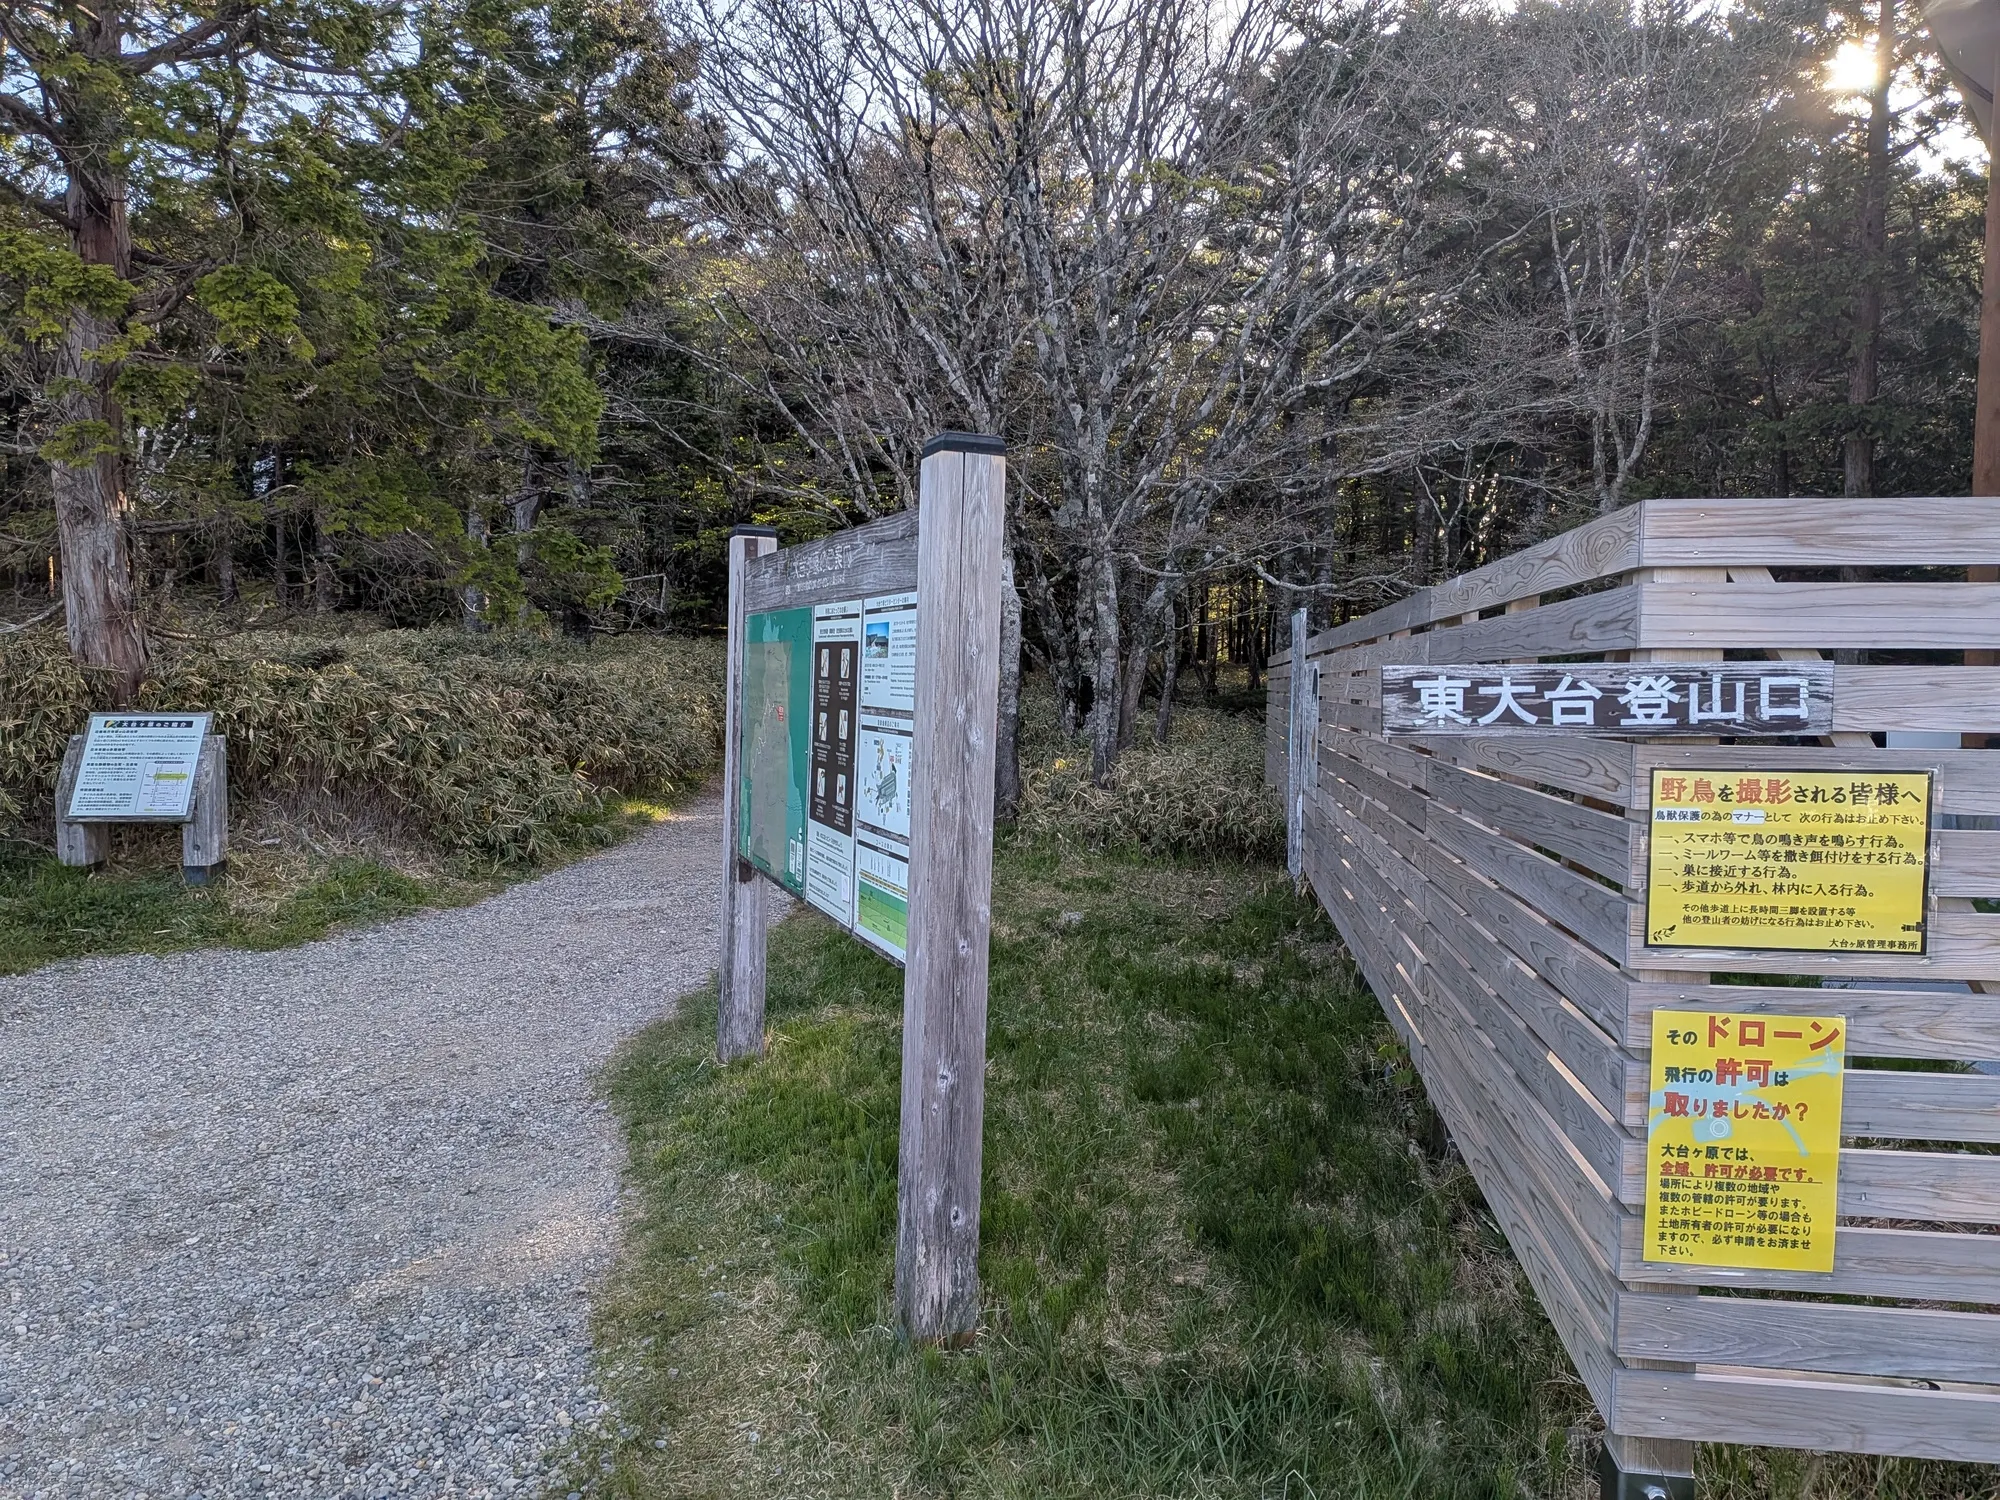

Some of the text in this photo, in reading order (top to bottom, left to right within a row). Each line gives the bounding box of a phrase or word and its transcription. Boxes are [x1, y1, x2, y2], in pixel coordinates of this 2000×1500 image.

[1413, 673, 1809, 726] 東大台 登山口
[1661, 777, 1921, 806] 野鳥を撮影される皆様へ
[1655, 810, 1924, 826] 鳥獣保護の為のマナーとして 次の行為はお止め下さい。
[1659, 831, 1905, 849] 一、スマホ等で鳥の鳴き声を鳴らす行為。
[1658, 848, 1925, 866] 一、ミールワーム等を撒き餌付けをする行為。
[1658, 864, 1798, 880] 一、巣に接近する行為。
[1658, 881, 1875, 898] 一、歩道から外れ、林内に入る行為。
[1682, 903, 1856, 917] その他歩道上に長時間三脚を設置する等
[1682, 915, 1875, 929] 他の登山者の妨げになる行為はお止め下さい。
[1664, 1058, 1789, 1088] 飛行の許可は
[1659, 1178, 1780, 1194] 場所により複数の地域や
[1659, 1192, 1807, 1210] 複数の管轄の許可が要ります。
[1659, 1206, 1812, 1223] またホビードローン等の場合も
[1658, 1220, 1812, 1237] 土地所有者の許可が必要になり
[1657, 1231, 1811, 1250] ますので、必ず申請をお済ませ
[1657, 1245, 1694, 1257] 下さい。
